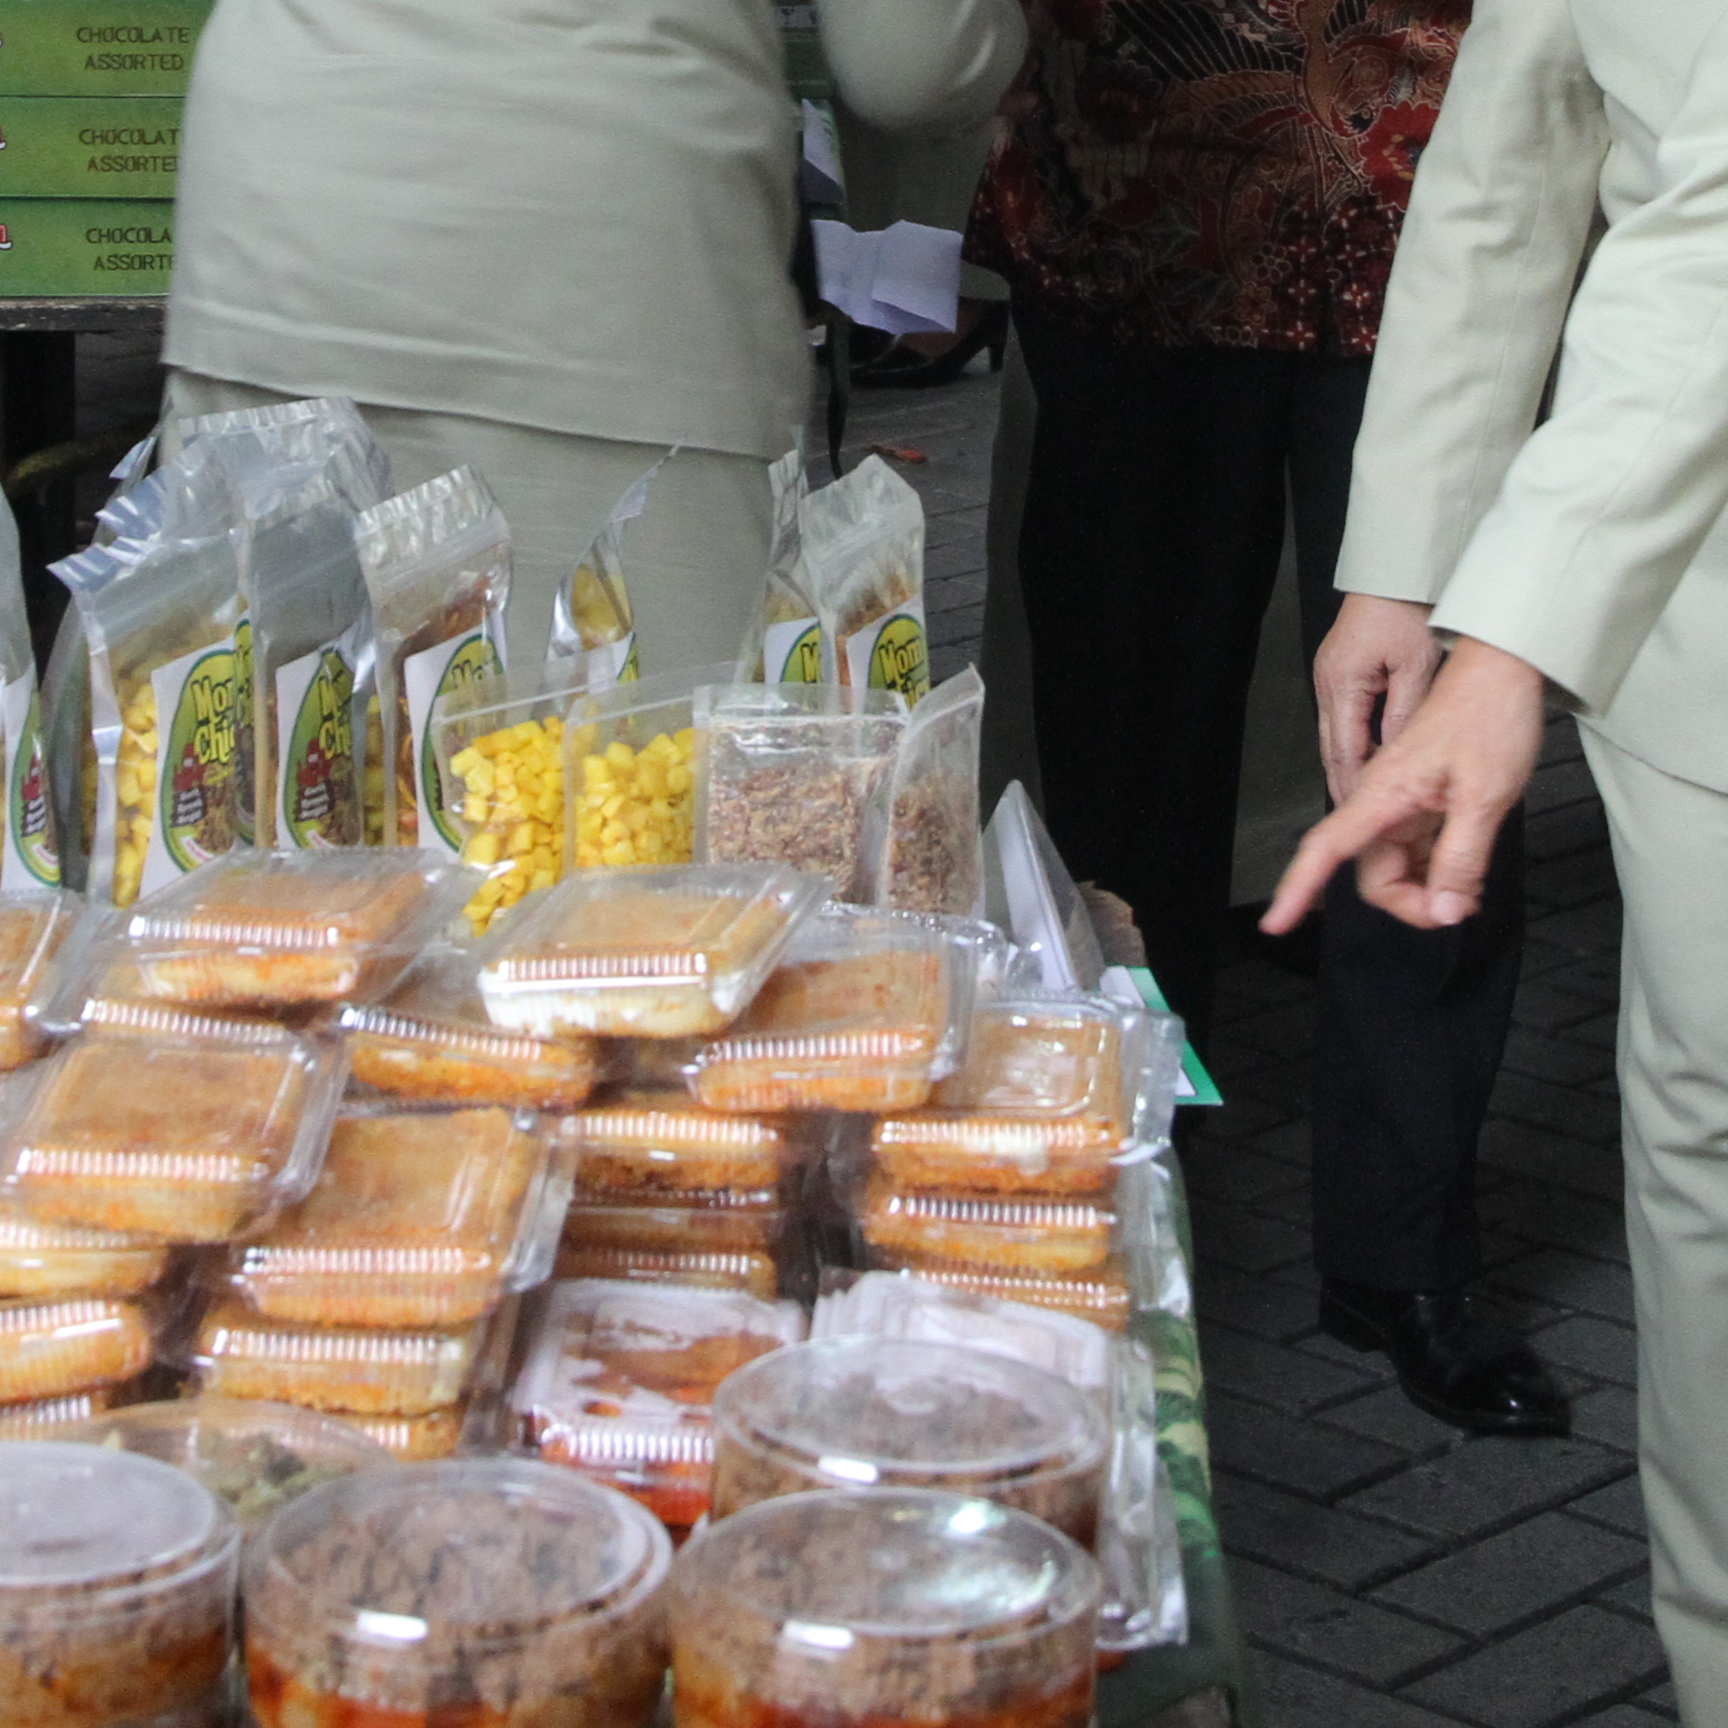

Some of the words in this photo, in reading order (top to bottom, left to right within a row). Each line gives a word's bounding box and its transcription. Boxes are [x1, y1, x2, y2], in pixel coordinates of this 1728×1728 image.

[76, 26, 191, 44] CHOCOLATE
[84, 52, 185, 71] ASSORTED
[78, 128, 180, 145] CHOCOLAT
[85, 227, 172, 244] CHOCOLA
[93, 253, 175, 271] ASSORT
